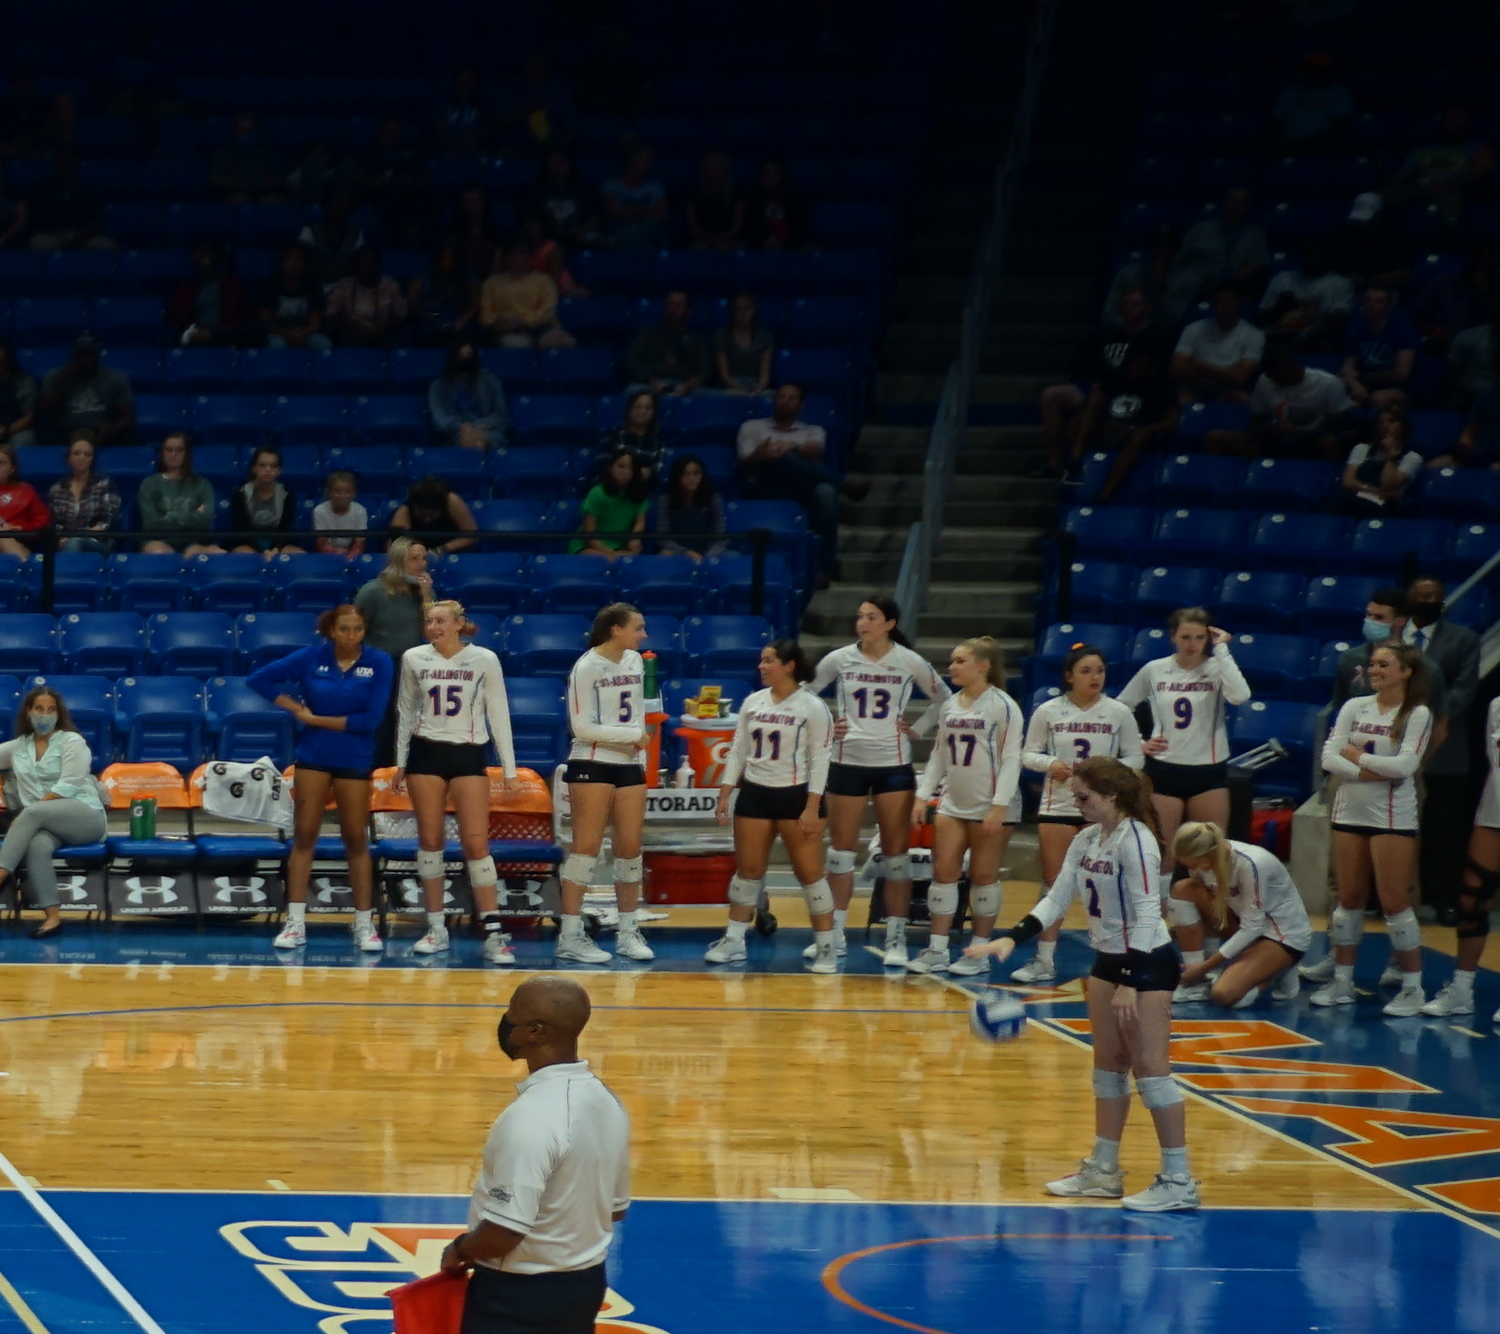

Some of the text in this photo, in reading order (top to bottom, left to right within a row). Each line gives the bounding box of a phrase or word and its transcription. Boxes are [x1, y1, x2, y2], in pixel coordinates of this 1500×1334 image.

[428, 685, 464, 717] 15
[619, 691, 632, 723] 5
[853, 687, 891, 720] 13
[1173, 697, 1193, 730] 9
[752, 727, 781, 761] 11
[946, 734, 977, 767] 17
[646, 797, 715, 812] TORAD
